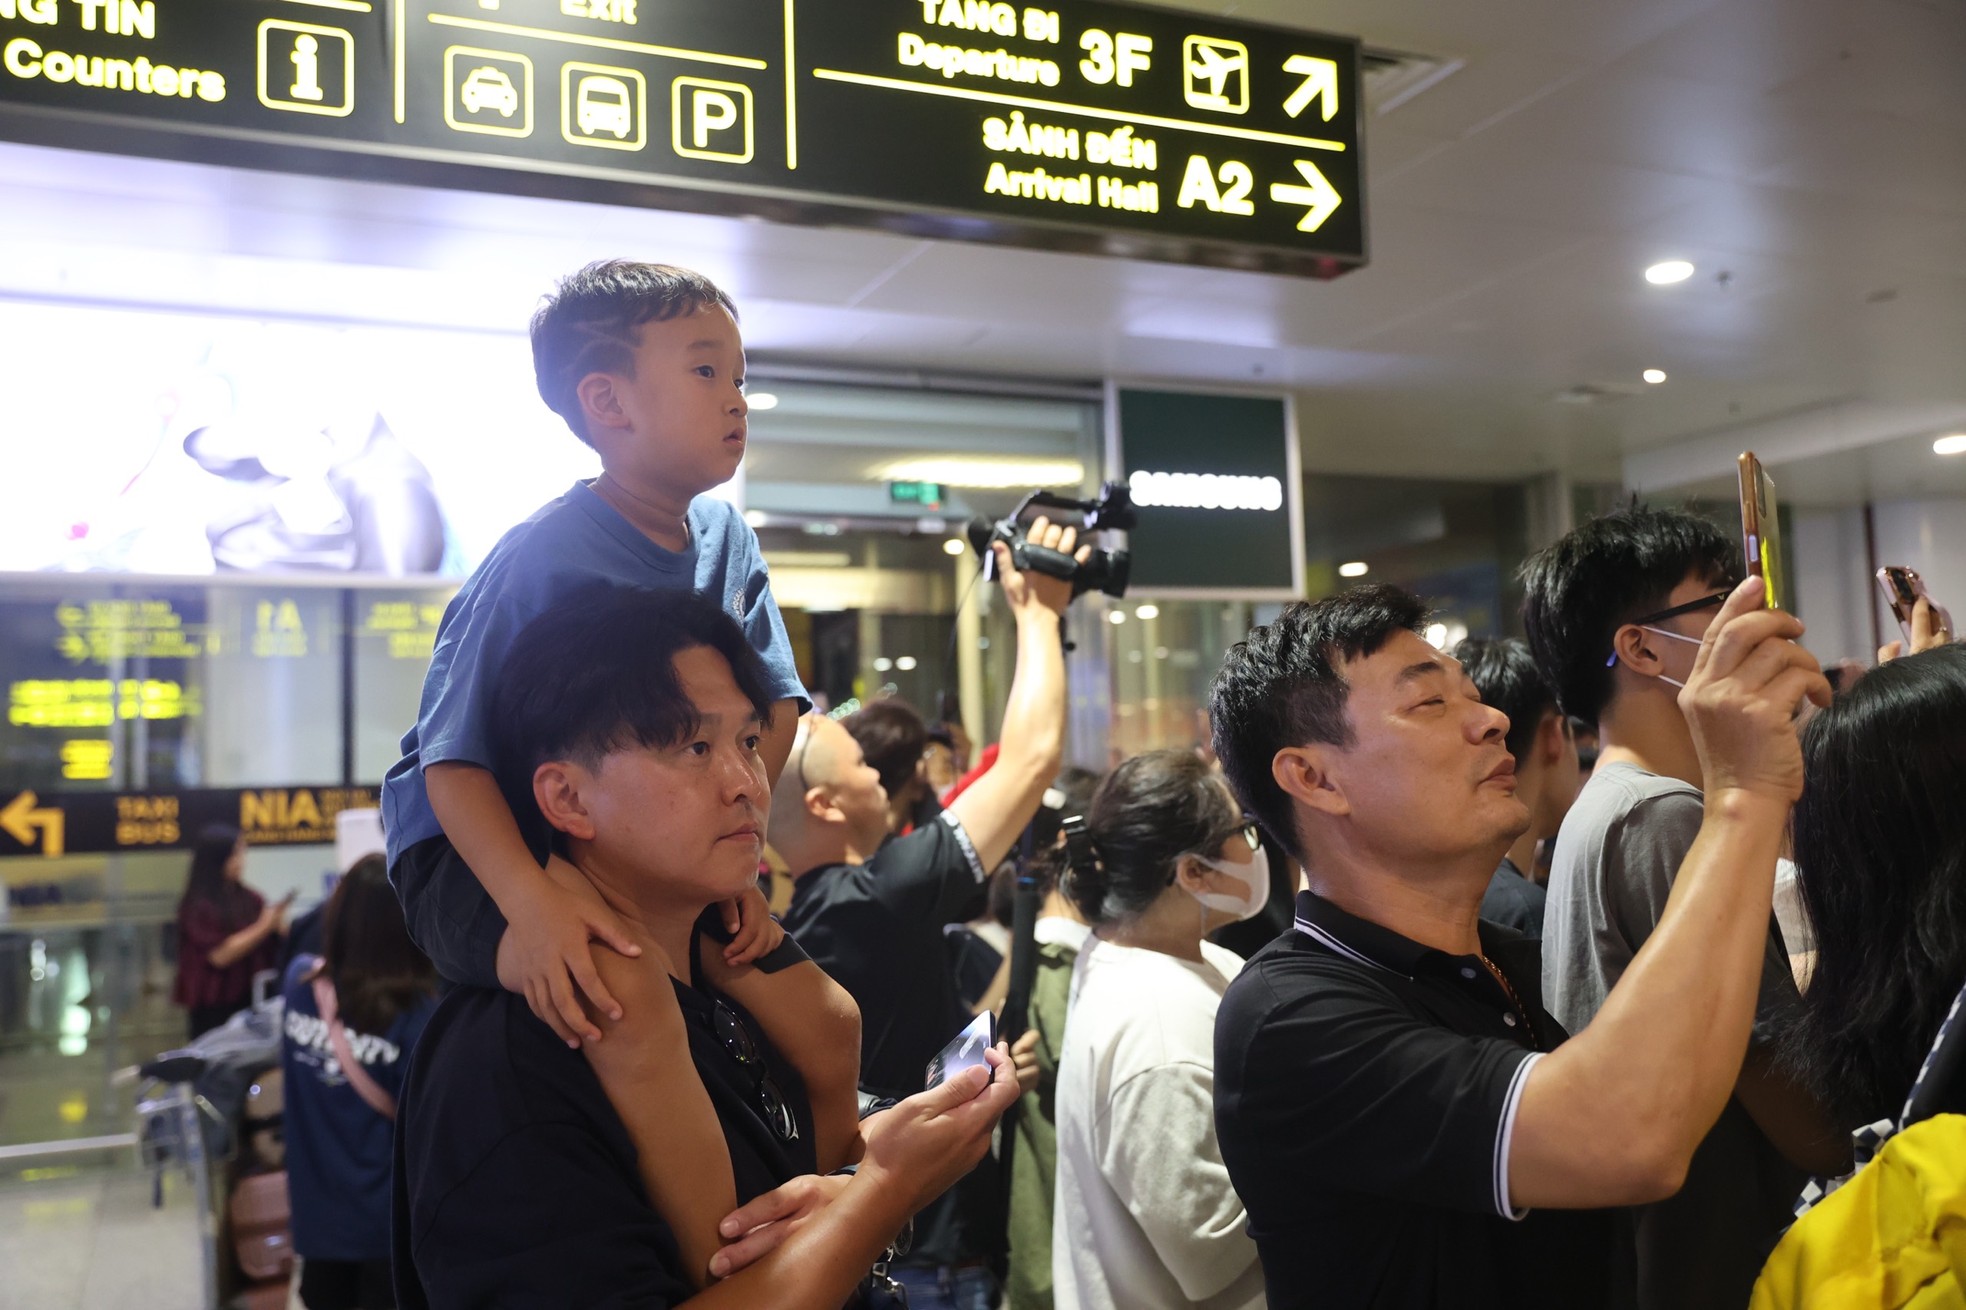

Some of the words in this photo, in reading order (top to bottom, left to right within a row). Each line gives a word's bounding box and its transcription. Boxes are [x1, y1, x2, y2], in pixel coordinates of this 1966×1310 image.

[72, 0, 156, 39] TIN
[4, 38, 226, 102] Counters
[898, 32, 1060, 87] Departure
[1079, 29, 1153, 87] 3F
[984, 162, 1092, 205] Arrival
[1097, 175, 1159, 213] Hall
[1177, 154, 1255, 216] A2
[116, 820, 181, 845] BUS
